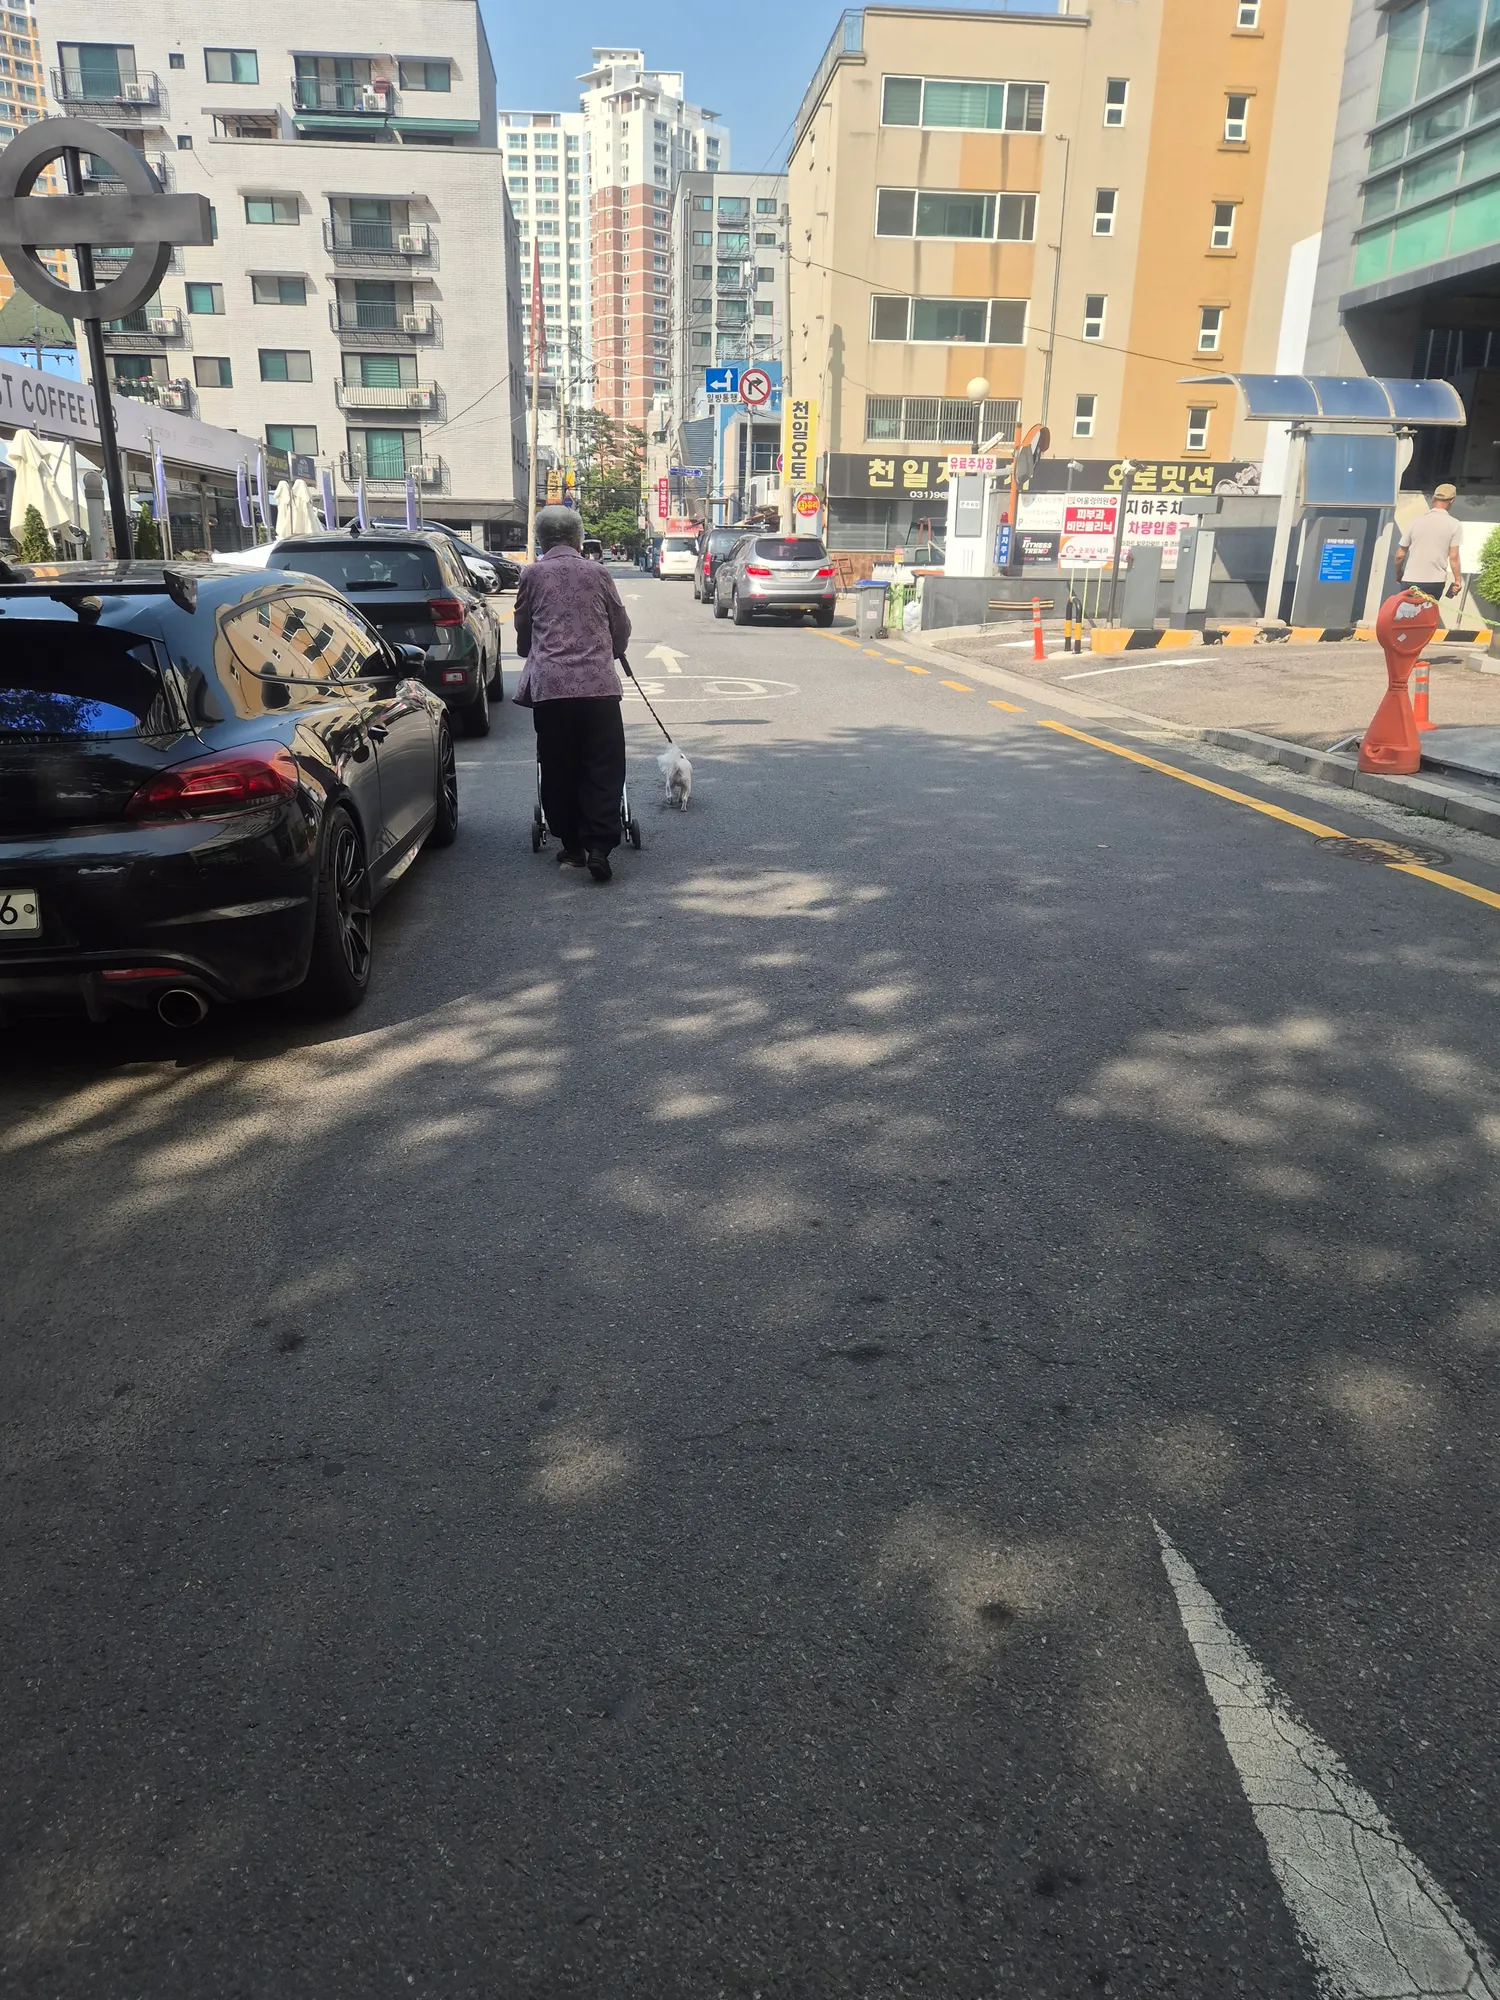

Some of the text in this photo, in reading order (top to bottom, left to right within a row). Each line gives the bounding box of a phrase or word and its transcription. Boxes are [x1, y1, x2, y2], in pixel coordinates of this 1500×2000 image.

[706, 393, 743, 403] 일방통행
[22, 379, 87, 426] COFFEE
[90, 399, 119, 433] LB
[790, 400, 809, 480] 천일오토
[949, 457, 995, 470] 유료주차장
[1077, 509, 1105, 520] 피부과
[1126, 500, 1182, 515] 지하주차
